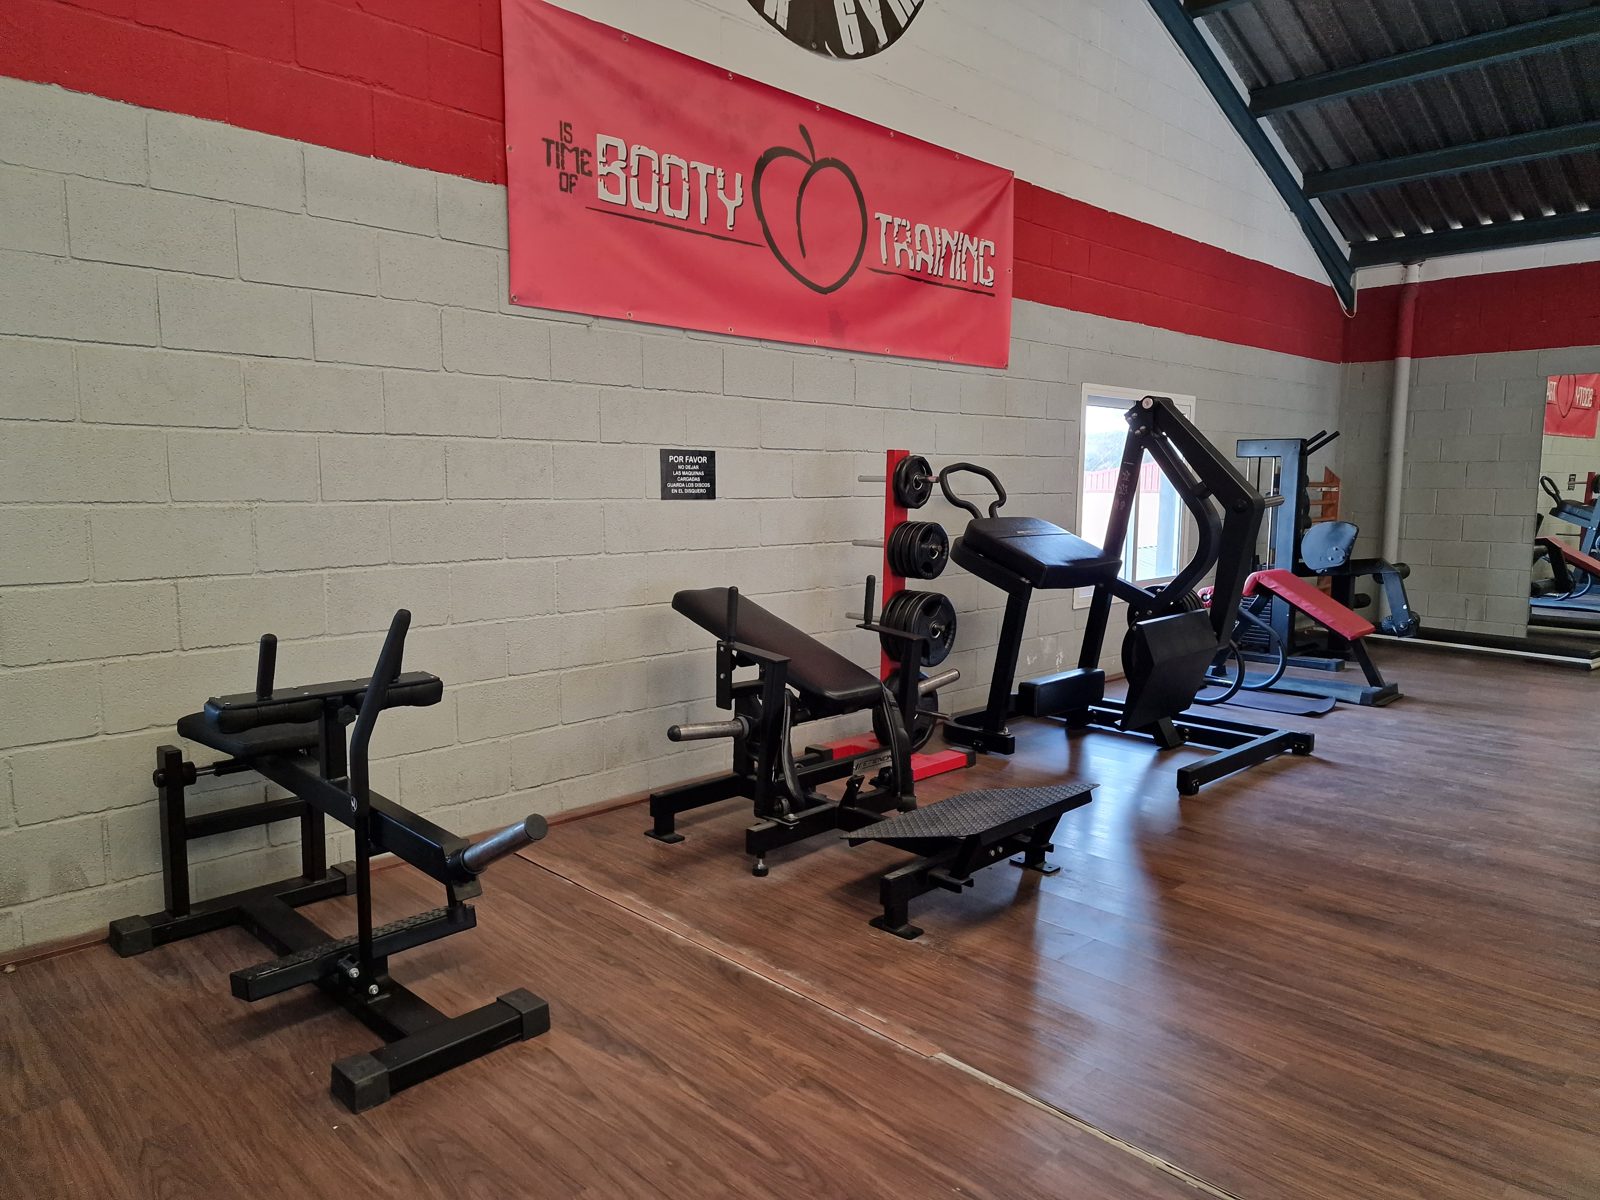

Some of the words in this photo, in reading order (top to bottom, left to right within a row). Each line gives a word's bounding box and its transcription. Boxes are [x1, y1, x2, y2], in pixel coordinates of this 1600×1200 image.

[559, 120, 573, 144] IS
[542, 137, 593, 177] TIME
[559, 172, 578, 193] OF
[596, 133, 743, 231] BOOTY
[874, 212, 995, 287] TRAINING
[668, 455, 684, 463] POR
[685, 455, 708, 464] FAVOR
